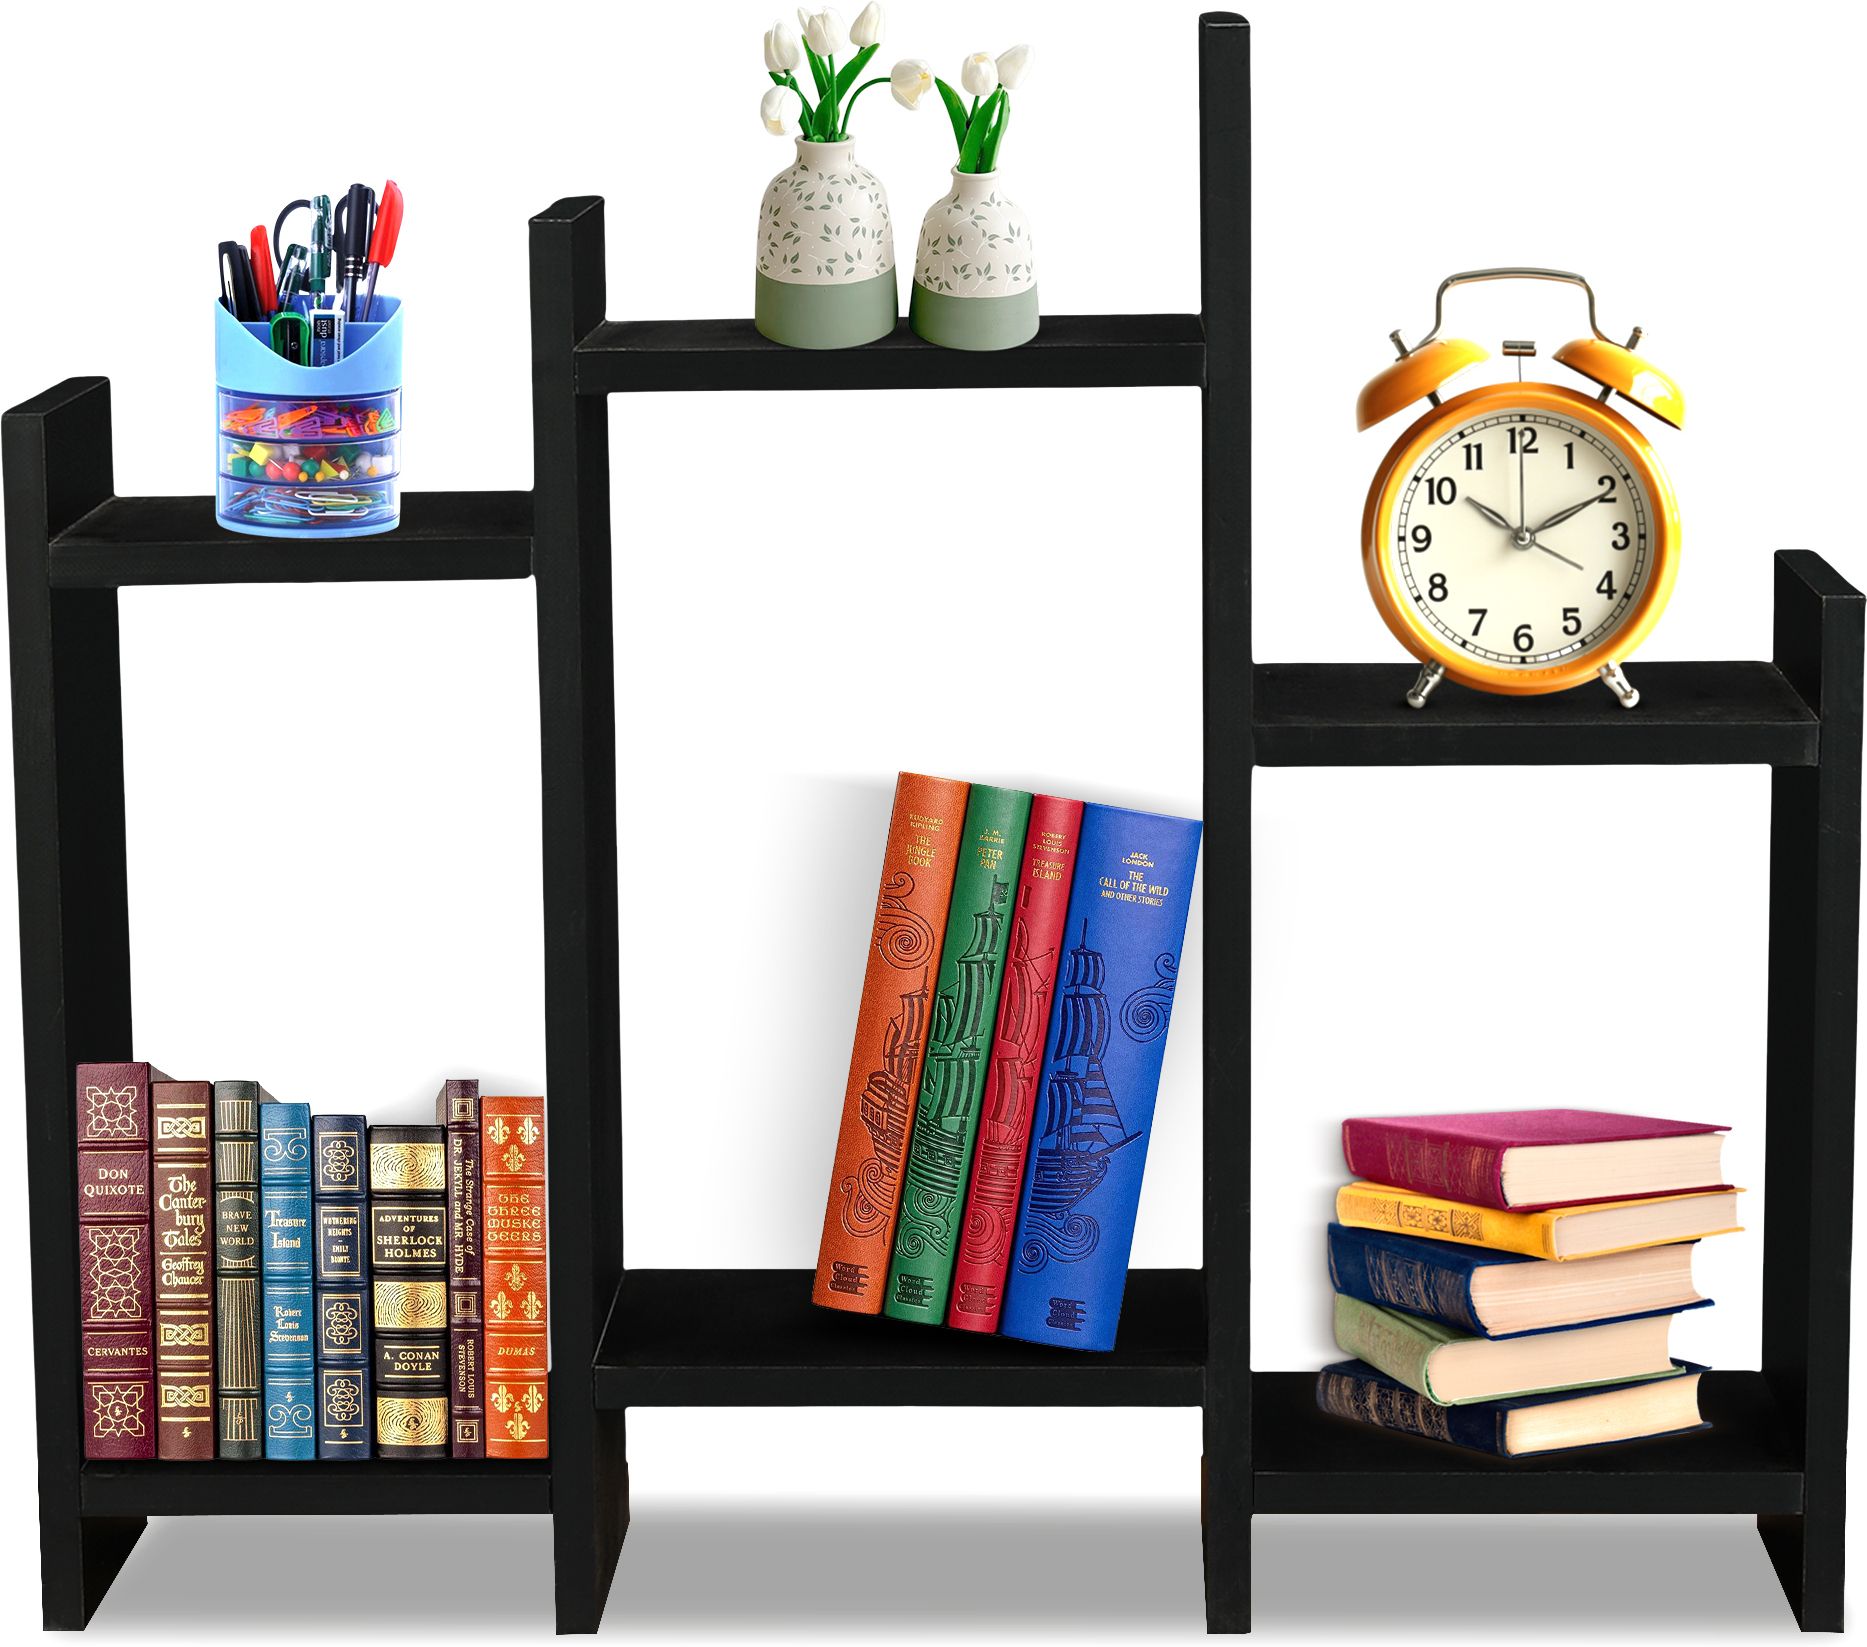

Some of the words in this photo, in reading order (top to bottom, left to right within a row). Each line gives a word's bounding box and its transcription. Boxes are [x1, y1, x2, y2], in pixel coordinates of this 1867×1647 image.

[1506, 427, 1538, 454] 12
[1463, 443, 1484, 470] 11
[1564, 442, 1574, 469] 1
[1424, 477, 1456, 505] 10
[1597, 475, 1617, 503] 2
[1411, 525, 1432, 552] 9
[1611, 522, 1630, 550] 3
[1428, 573, 1448, 602] 8
[1596, 571, 1617, 600] 4
[1468, 608, 1487, 636] 7
[1562, 608, 1581, 635] 5
[1513, 624, 1534, 652] 6
[910, 822, 940, 831] KIPLING
[916, 835, 931, 846] THE
[906, 845, 936, 857] JUNGLE
[978, 847, 1003, 860] PETER
[1130, 852, 1148, 860] JACK
[908, 855, 932, 868] BOOK
[980, 859, 997, 870] PAN
[1032, 858, 1065, 870] TREASURE
[1122, 857, 1154, 868] LONDON
[1032, 868, 1062, 880] ISLAND
[1129, 870, 1144, 882] THE
[1099, 876, 1118, 888] CALL
[1120, 880, 1130, 890] OF
[1132, 882, 1147, 893] THE
[1149, 885, 1169, 896] WILD
[1101, 890, 1114, 898] AND
[1116, 892, 1137, 902] OTHER
[1138, 896, 1163, 906] STORIES
[453, 1138, 462, 1157] DR.
[99, 1168, 128, 1180] DON
[465, 1159, 474, 1176] The
[168, 1174, 197, 1192] The
[454, 1160, 462, 1198] JEKYLL
[84, 1184, 144, 1198] QUIXOTE
[464, 1179, 474, 1216] Strange
[159, 1194, 206, 1212] Canter-
[222, 1211, 252, 1220] BRAVE
[454, 1201, 463, 1219] and
[176, 1210, 204, 1234] bury
[265, 1210, 307, 1228] Treasure
[226, 1224, 248, 1232] NEW
[454, 1222, 463, 1240] MR.
[466, 1218, 474, 1242] Case
[162, 1228, 202, 1249] Tales
[220, 1236, 254, 1246] WORLD
[270, 1232, 300, 1248] Island
[376, 1235, 443, 1246] SHERLOCK
[384, 1249, 437, 1258] HOLMES
[465, 1245, 475, 1256] of
[455, 1244, 464, 1273] HYDE
[162, 1258, 205, 1276] Geoffrey
[835, 1263, 856, 1274] Word
[162, 1270, 204, 1287] Chaucer
[835, 1273, 858, 1283] Cloud
[901, 1275, 920, 1284] Word
[900, 1286, 923, 1295] Cloud
[1053, 1299, 1072, 1309] Word
[273, 1306, 302, 1317] Robert
[1052, 1309, 1075, 1318] Cloud
[276, 1318, 299, 1329] Louis
[269, 1330, 309, 1343] Stevenson
[88, 1347, 148, 1356] CERVANTES
[384, 1352, 394, 1360] A.
[399, 1351, 440, 1360] CONAN
[498, 1347, 536, 1356] DUMAS
[394, 1362, 432, 1371] DOYLE
